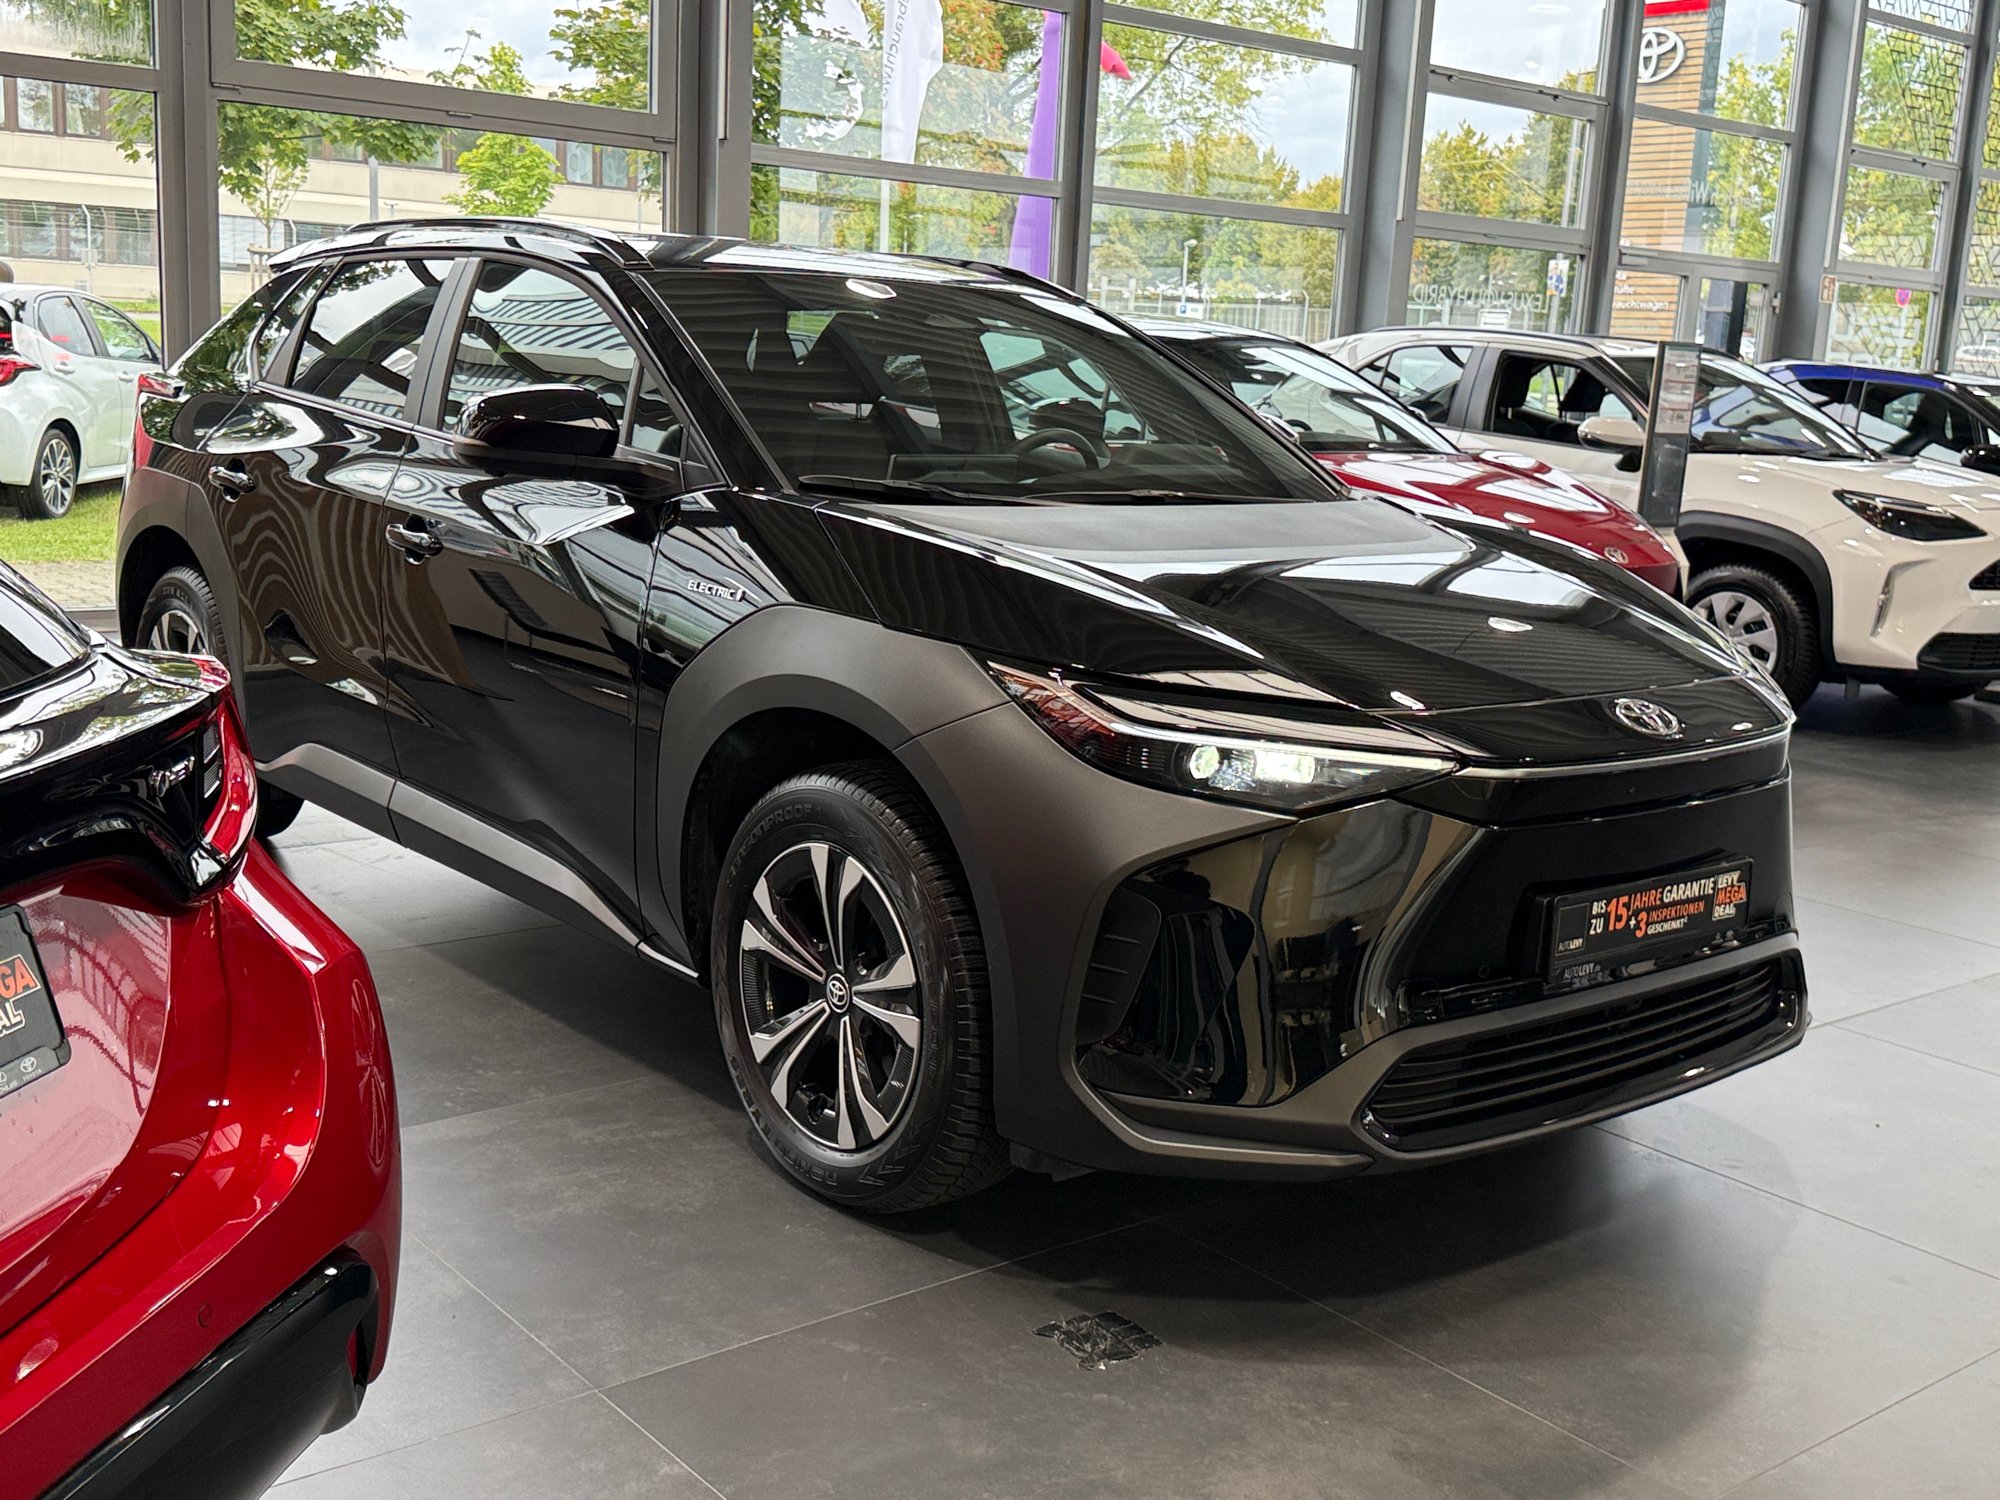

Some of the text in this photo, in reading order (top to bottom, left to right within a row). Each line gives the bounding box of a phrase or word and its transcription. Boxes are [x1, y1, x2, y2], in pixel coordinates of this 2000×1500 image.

[687, 579, 736, 600] ELECTRIC
[1718, 871, 1741, 888] LEVY
[1628, 888, 1663, 915] JAHRE
[1716, 885, 1745, 905] MEGA
[1592, 899, 1607, 915] BIS
[1607, 895, 1629, 931] 15
[1649, 900, 1705, 922] INSPEKTIONEN
[1714, 903, 1736, 918] DEAL
[1589, 917, 1604, 935] ZU
[0, 957, 36, 998] GA
